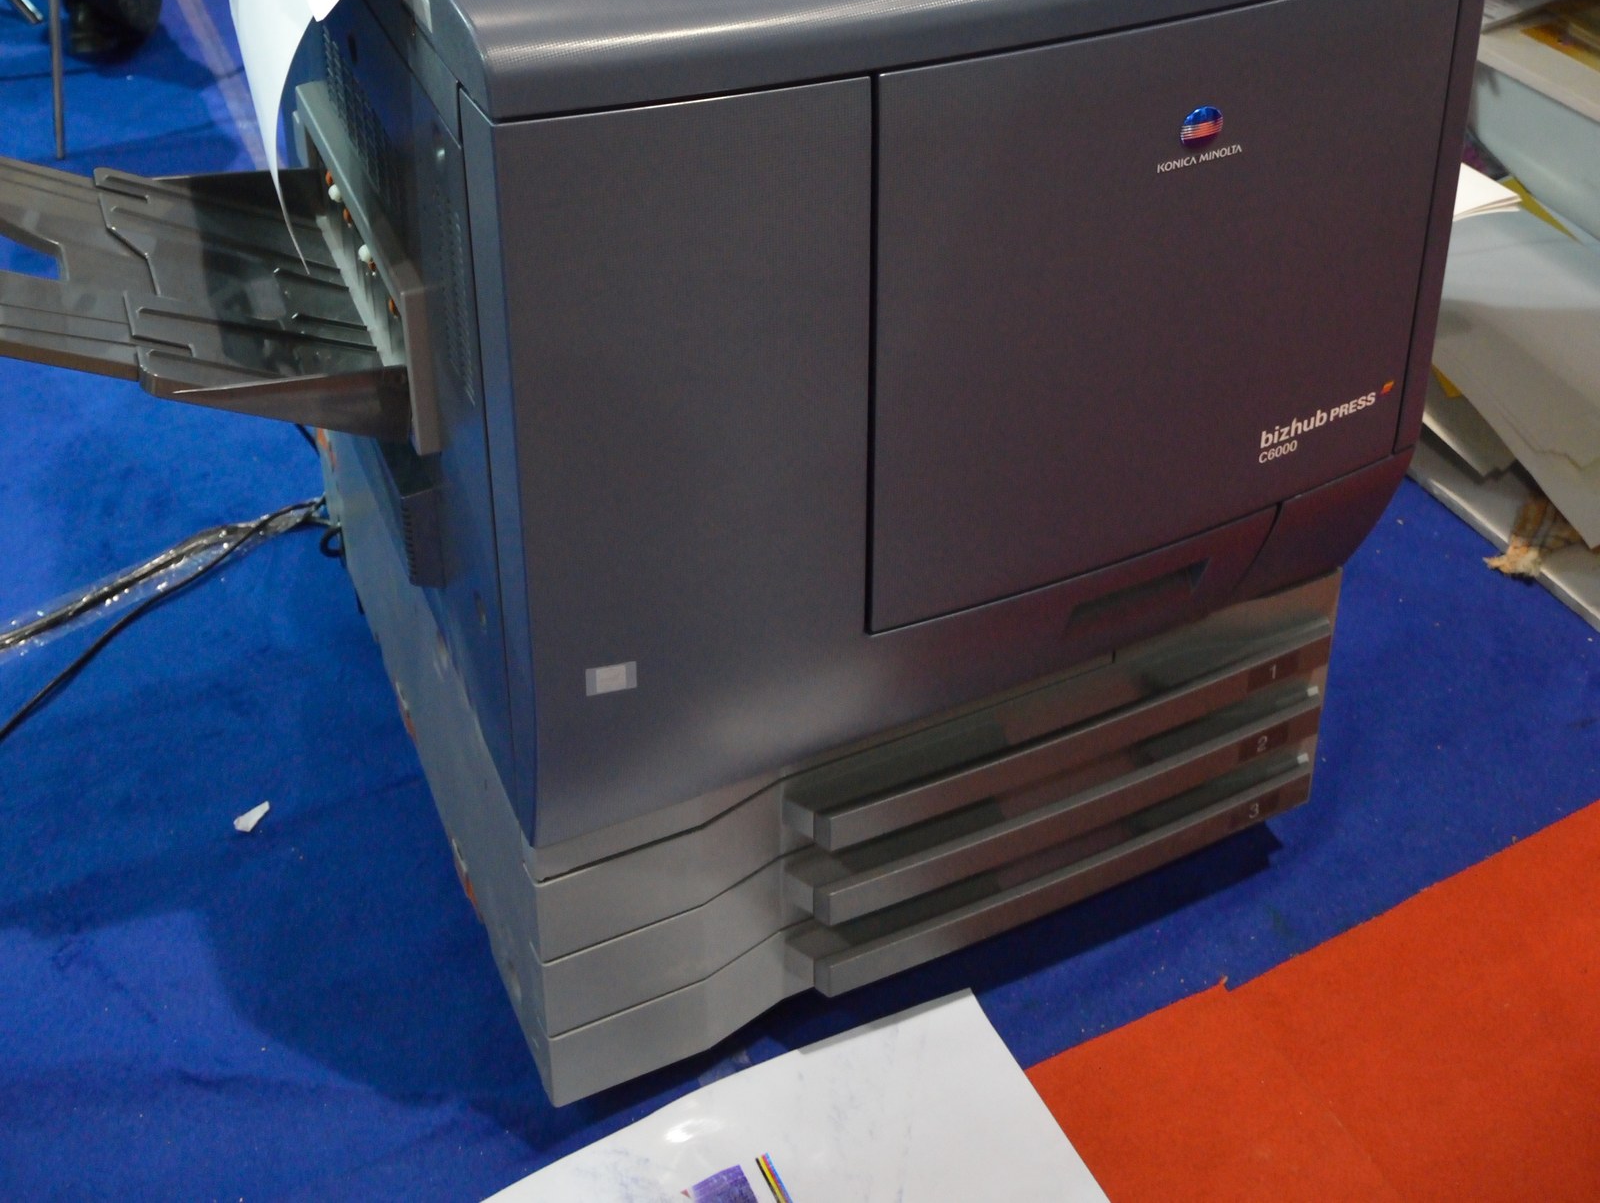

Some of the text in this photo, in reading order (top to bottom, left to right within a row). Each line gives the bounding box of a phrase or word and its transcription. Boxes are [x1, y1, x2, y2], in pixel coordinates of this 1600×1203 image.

[1156, 144, 1243, 174] KONICA MINOLTA
[1259, 391, 1377, 449] bizhub PRESS
[1258, 439, 1299, 464] C6000
[1269, 664, 1277, 679] 1
[1257, 735, 1268, 752] 2
[1249, 803, 1260, 819] 3
